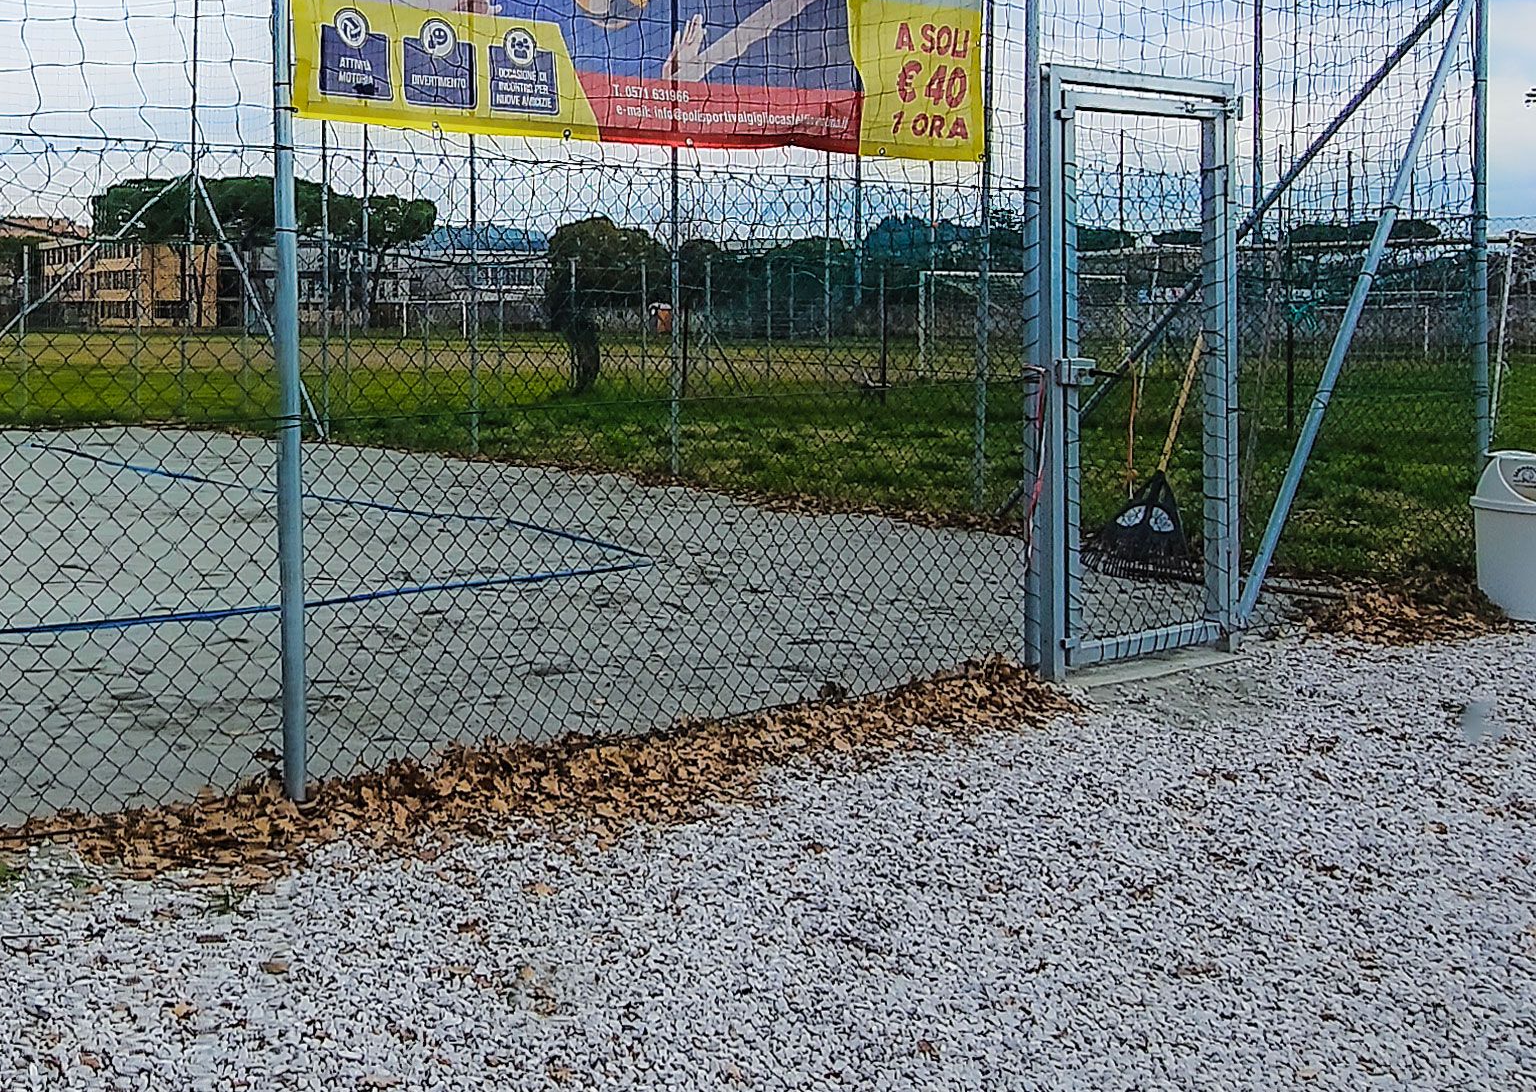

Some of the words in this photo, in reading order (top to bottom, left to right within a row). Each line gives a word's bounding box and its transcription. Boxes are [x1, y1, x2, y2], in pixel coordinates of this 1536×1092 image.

[895, 22, 916, 52] A
[920, 23, 970, 59] SOLI
[411, 73, 467, 89] DIVERTIMENTO
[498, 67, 537, 82] OCCASIONE
[534, 84, 549, 95] PER
[625, 86, 649, 99] 0571
[652, 88, 689, 103] 631966
[496, 93, 521, 107] NUOVE
[892, 110, 905, 135] 1
[911, 113, 969, 140] ORA
